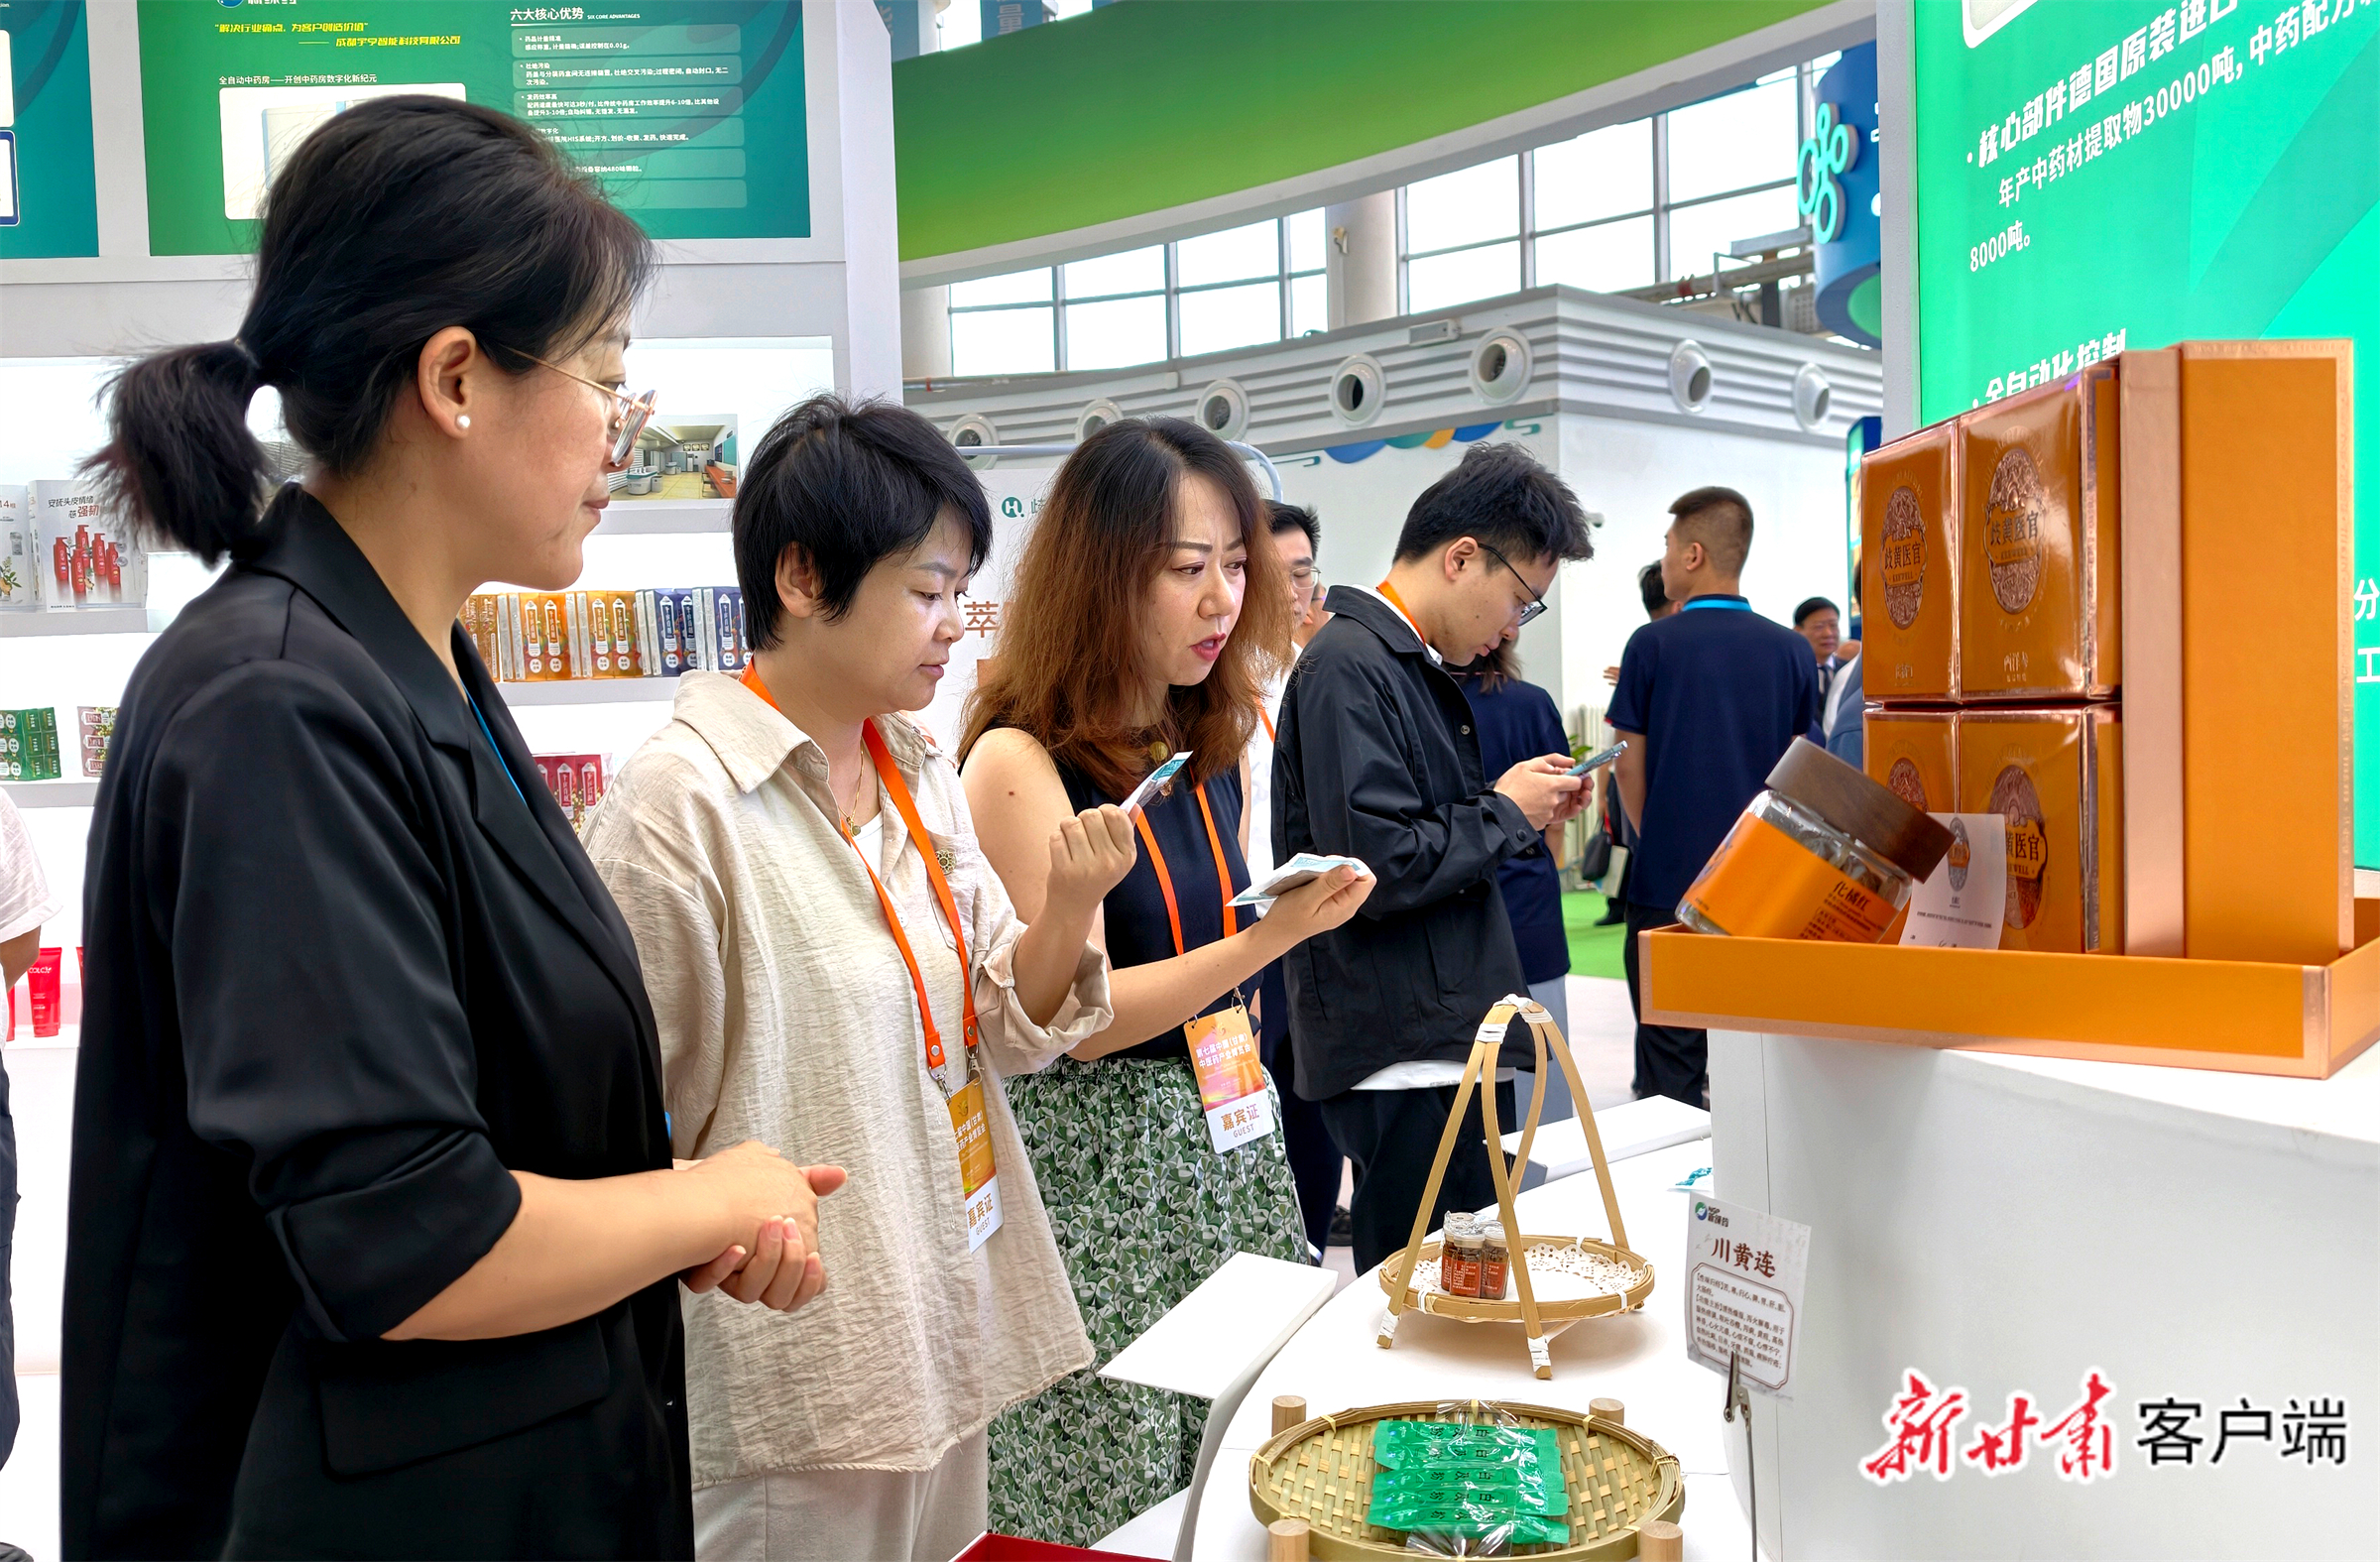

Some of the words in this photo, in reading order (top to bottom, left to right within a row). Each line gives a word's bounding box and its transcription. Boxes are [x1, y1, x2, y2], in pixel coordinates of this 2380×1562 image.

[511, 7, 584, 21] 六大核心优势
[1999, 0, 2380, 208] 年产中药材提取物30000吨，中药配方
[1985, 328, 2126, 405] 全自动化控制
[964, 601, 1000, 638] 萃
[1221, 1103, 1259, 1132] 嘉宾证
[1233, 1123, 1254, 1138] GUEST
[967, 1192, 994, 1230] 嘉宾证
[976, 1216, 991, 1236] GUEST
[1711, 1237, 1775, 1278] 川黄连
